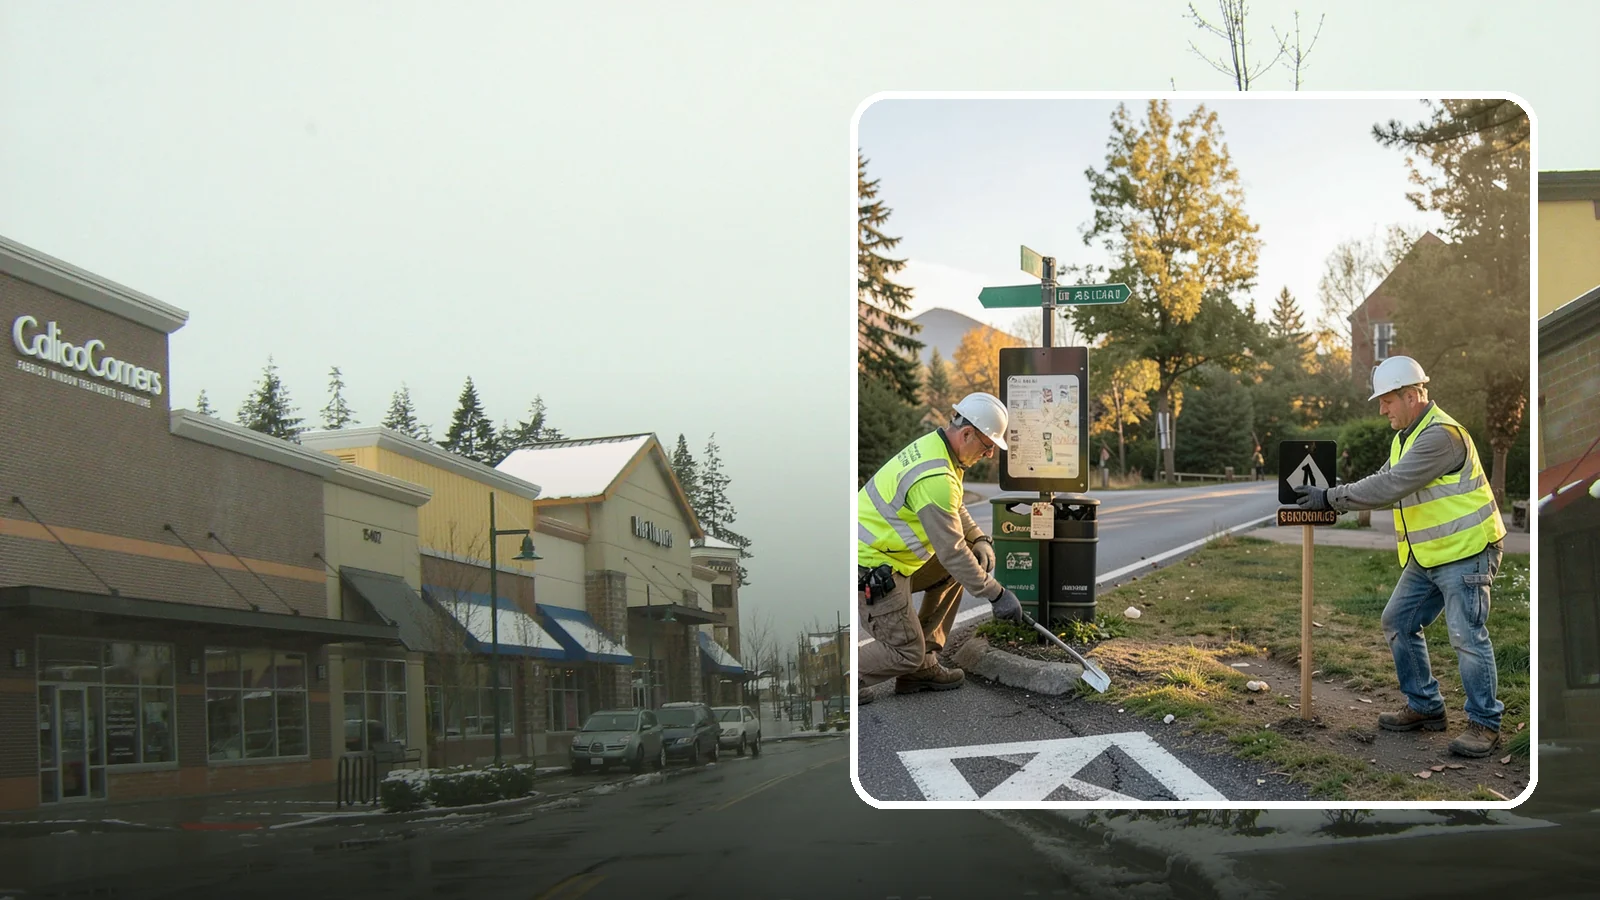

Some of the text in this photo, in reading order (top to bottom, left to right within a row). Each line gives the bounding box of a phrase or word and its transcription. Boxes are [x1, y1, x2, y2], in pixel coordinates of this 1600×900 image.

[17, 360, 47, 377] FABRICS
[51, 370, 78, 386] WINDOW
[79, 379, 116, 398] TREATMENTS
